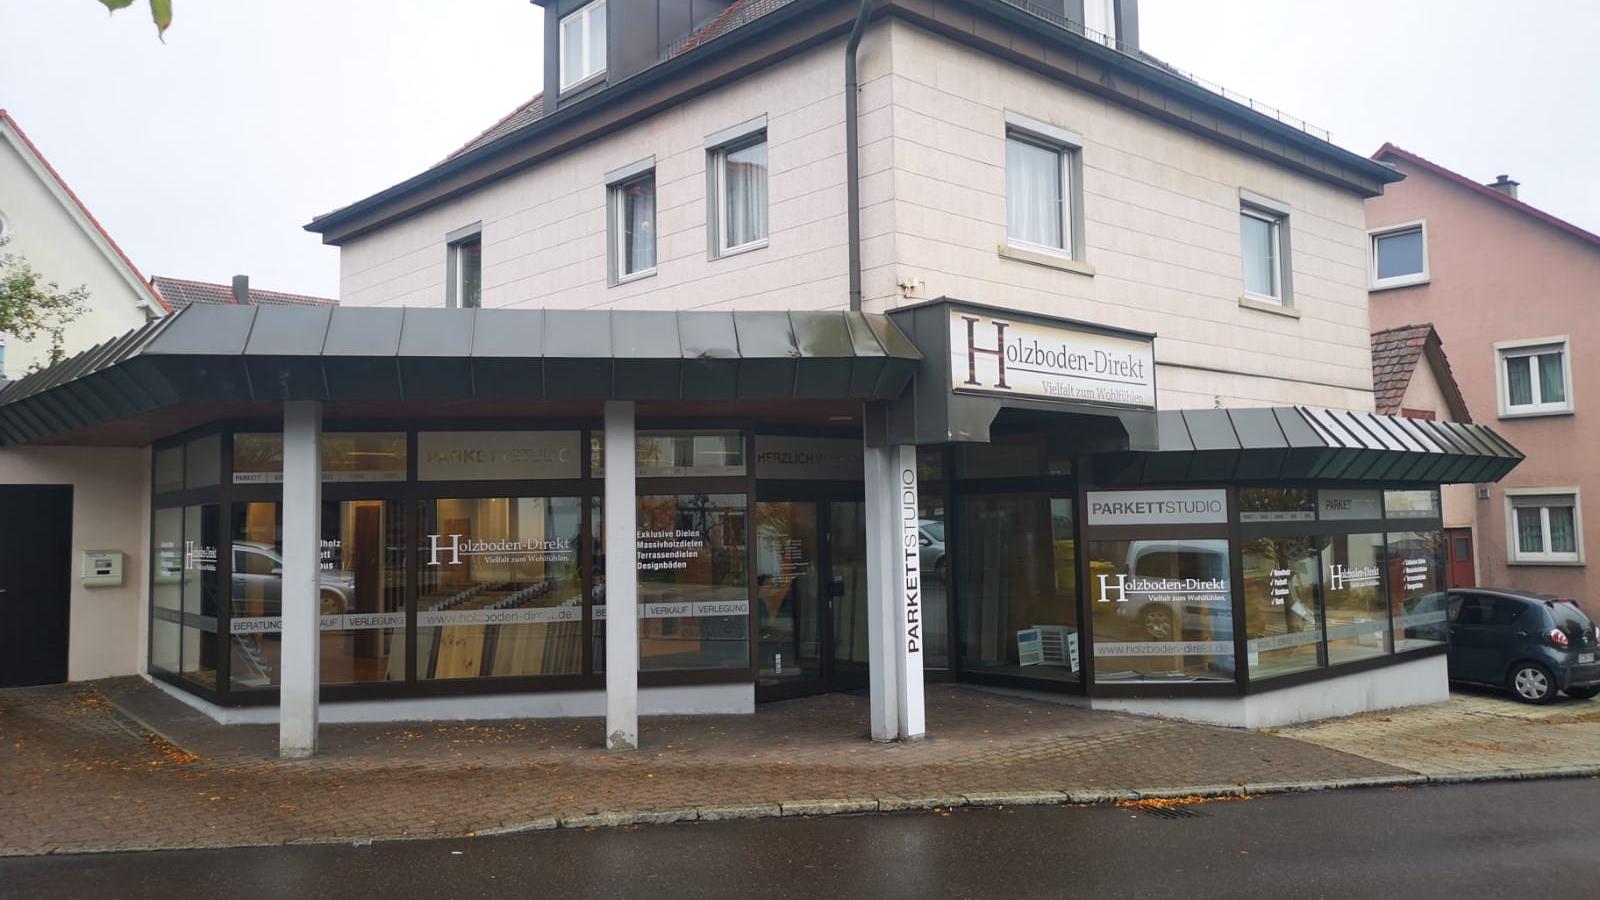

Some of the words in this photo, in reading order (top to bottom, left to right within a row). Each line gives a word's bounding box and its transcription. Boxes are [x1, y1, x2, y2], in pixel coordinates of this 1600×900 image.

[961, 315, 1144, 390] Holzboden-Direkt
[1042, 380, 1074, 398] Vielfalt
[1075, 386, 1096, 399] zum
[1092, 499, 1222, 515] PARKETTSTUDIO
[636, 530, 674, 538] Exklusive
[675, 529, 700, 537] Dielen
[427, 534, 569, 565] Holzboden-Direkt
[636, 540, 703, 549] Massivholzdielen
[485, 555, 510, 564] Vielfalt
[637, 550, 698, 559] Terrassendielen
[637, 561, 687, 570] Designböden
[901, 468, 920, 654] PARKETTSTUDIO
[1097, 573, 1225, 602] Holzboden-Direkt
[1148, 593, 1171, 602] Vielfalt
[650, 605, 689, 615] VERKAUF
[697, 603, 748, 614] VERLEGUNG
[233, 621, 282, 631] BERATUNG
[349, 615, 405, 627] VERLEGUNG
